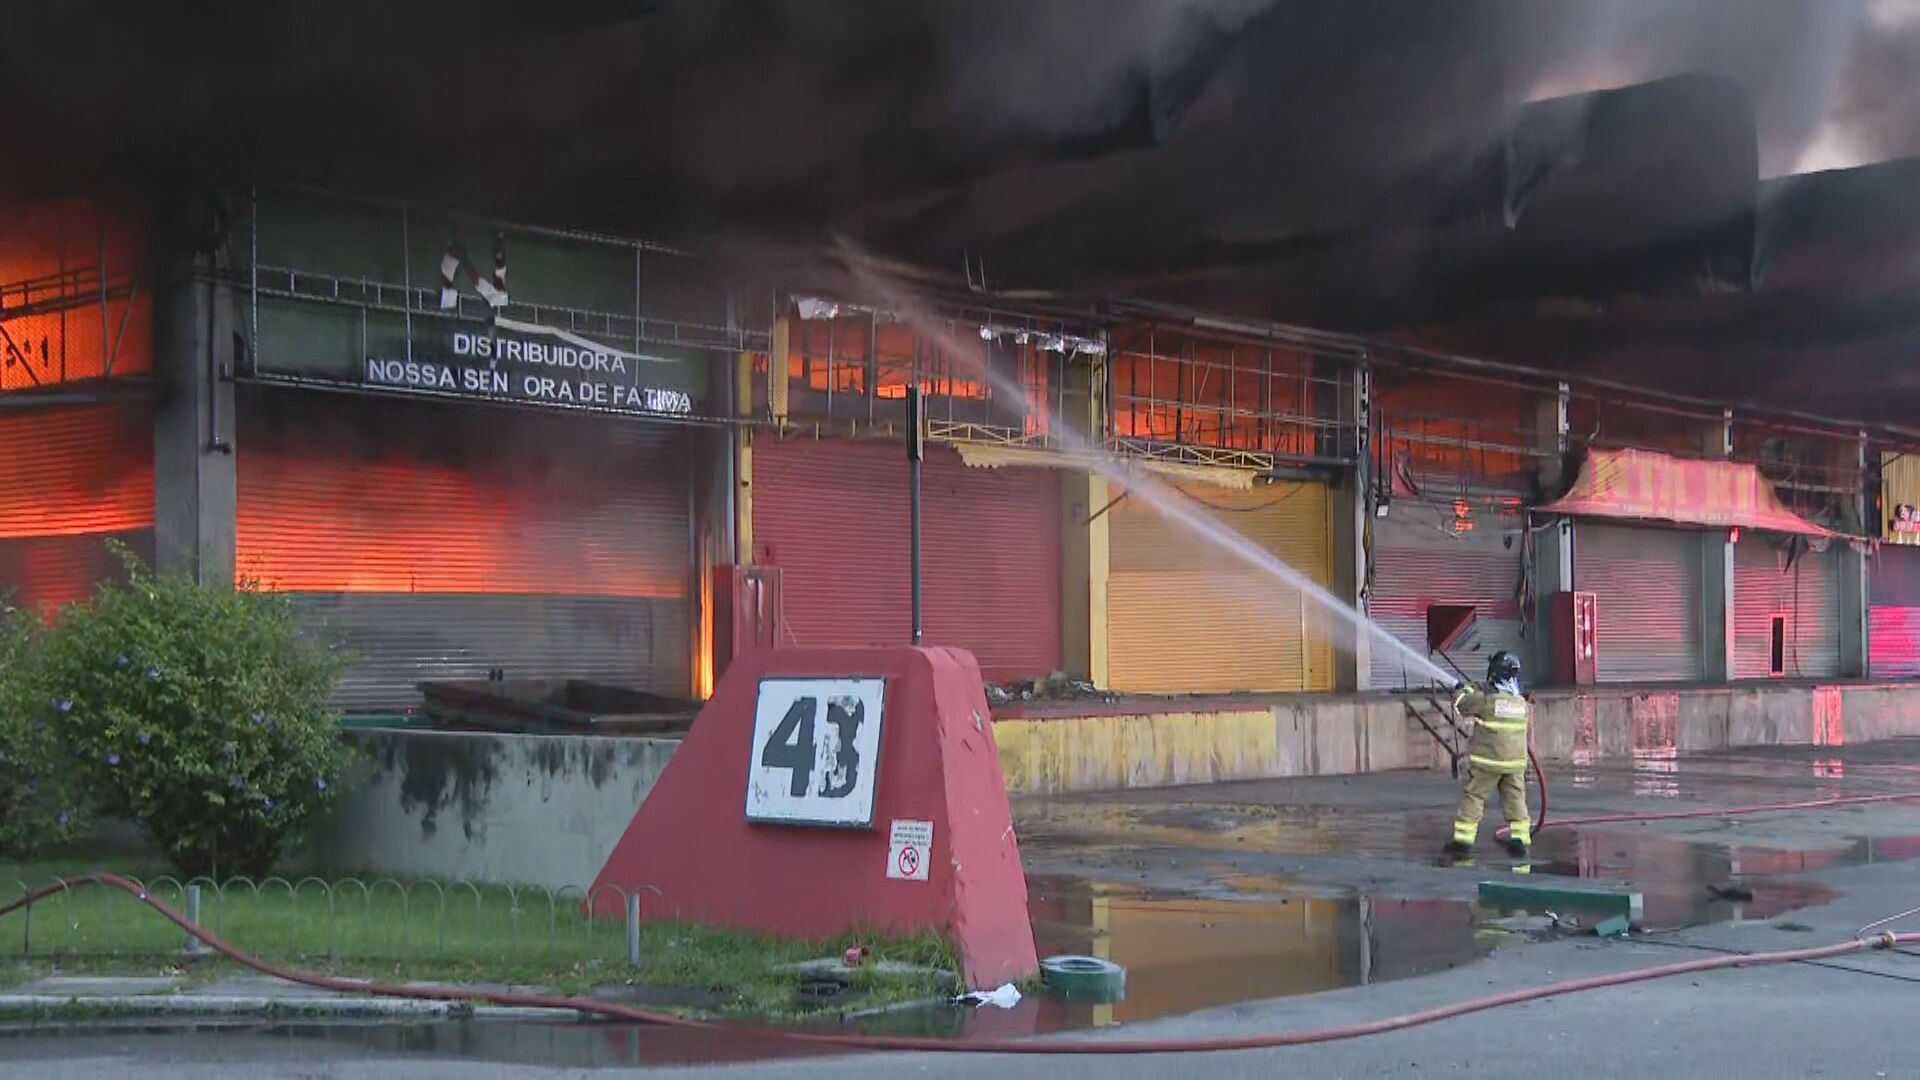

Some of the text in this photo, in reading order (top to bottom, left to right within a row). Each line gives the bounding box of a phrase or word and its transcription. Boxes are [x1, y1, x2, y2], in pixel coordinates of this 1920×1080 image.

[453, 332, 626, 374] DISTRIBUIDORA
[368, 359, 457, 389] NOSSA
[579, 381, 608, 403] DE
